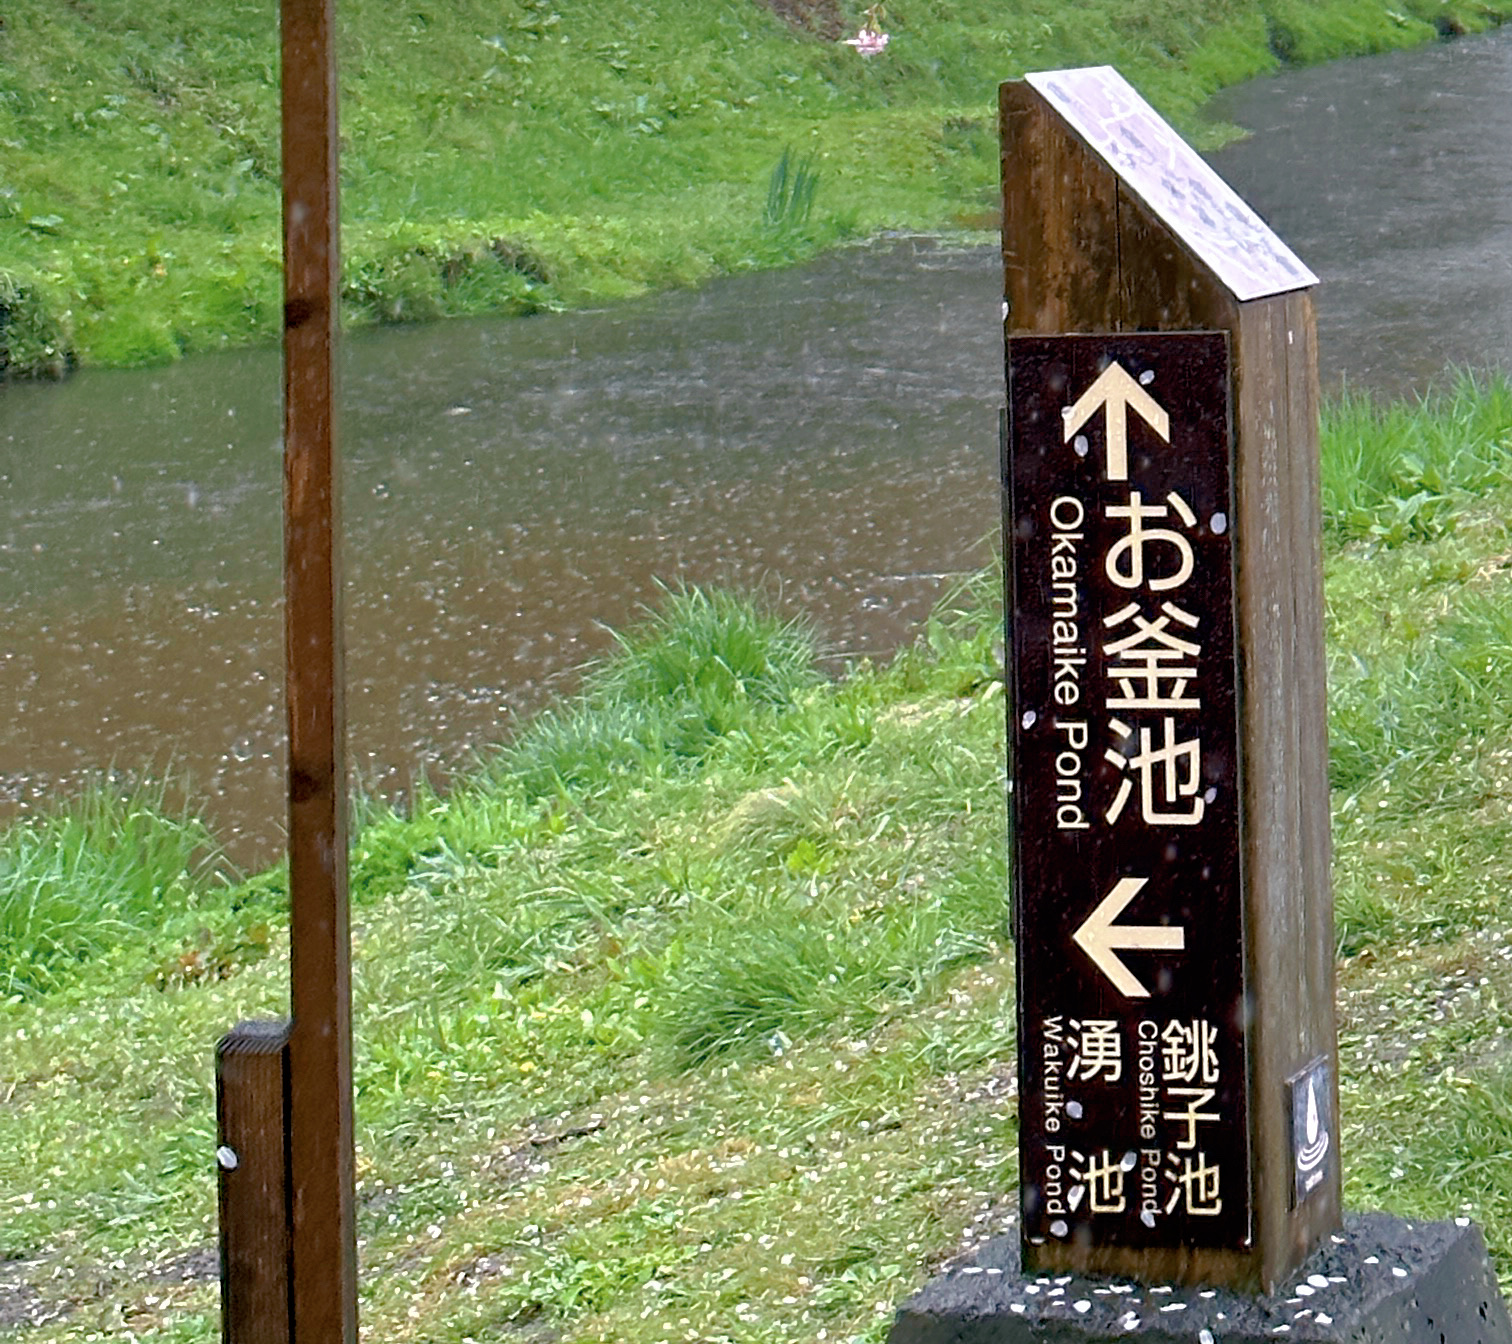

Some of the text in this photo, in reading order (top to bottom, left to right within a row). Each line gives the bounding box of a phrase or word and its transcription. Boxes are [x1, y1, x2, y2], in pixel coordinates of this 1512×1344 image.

[1049, 495, 1090, 830] Okamaike Pond
[1102, 490, 1205, 826] お釜池
[1043, 1014, 1067, 1215] Wakuike Pond
[1137, 1019, 1163, 1216] Choshike Pond
[1160, 1018, 1223, 1216] 銚子池
